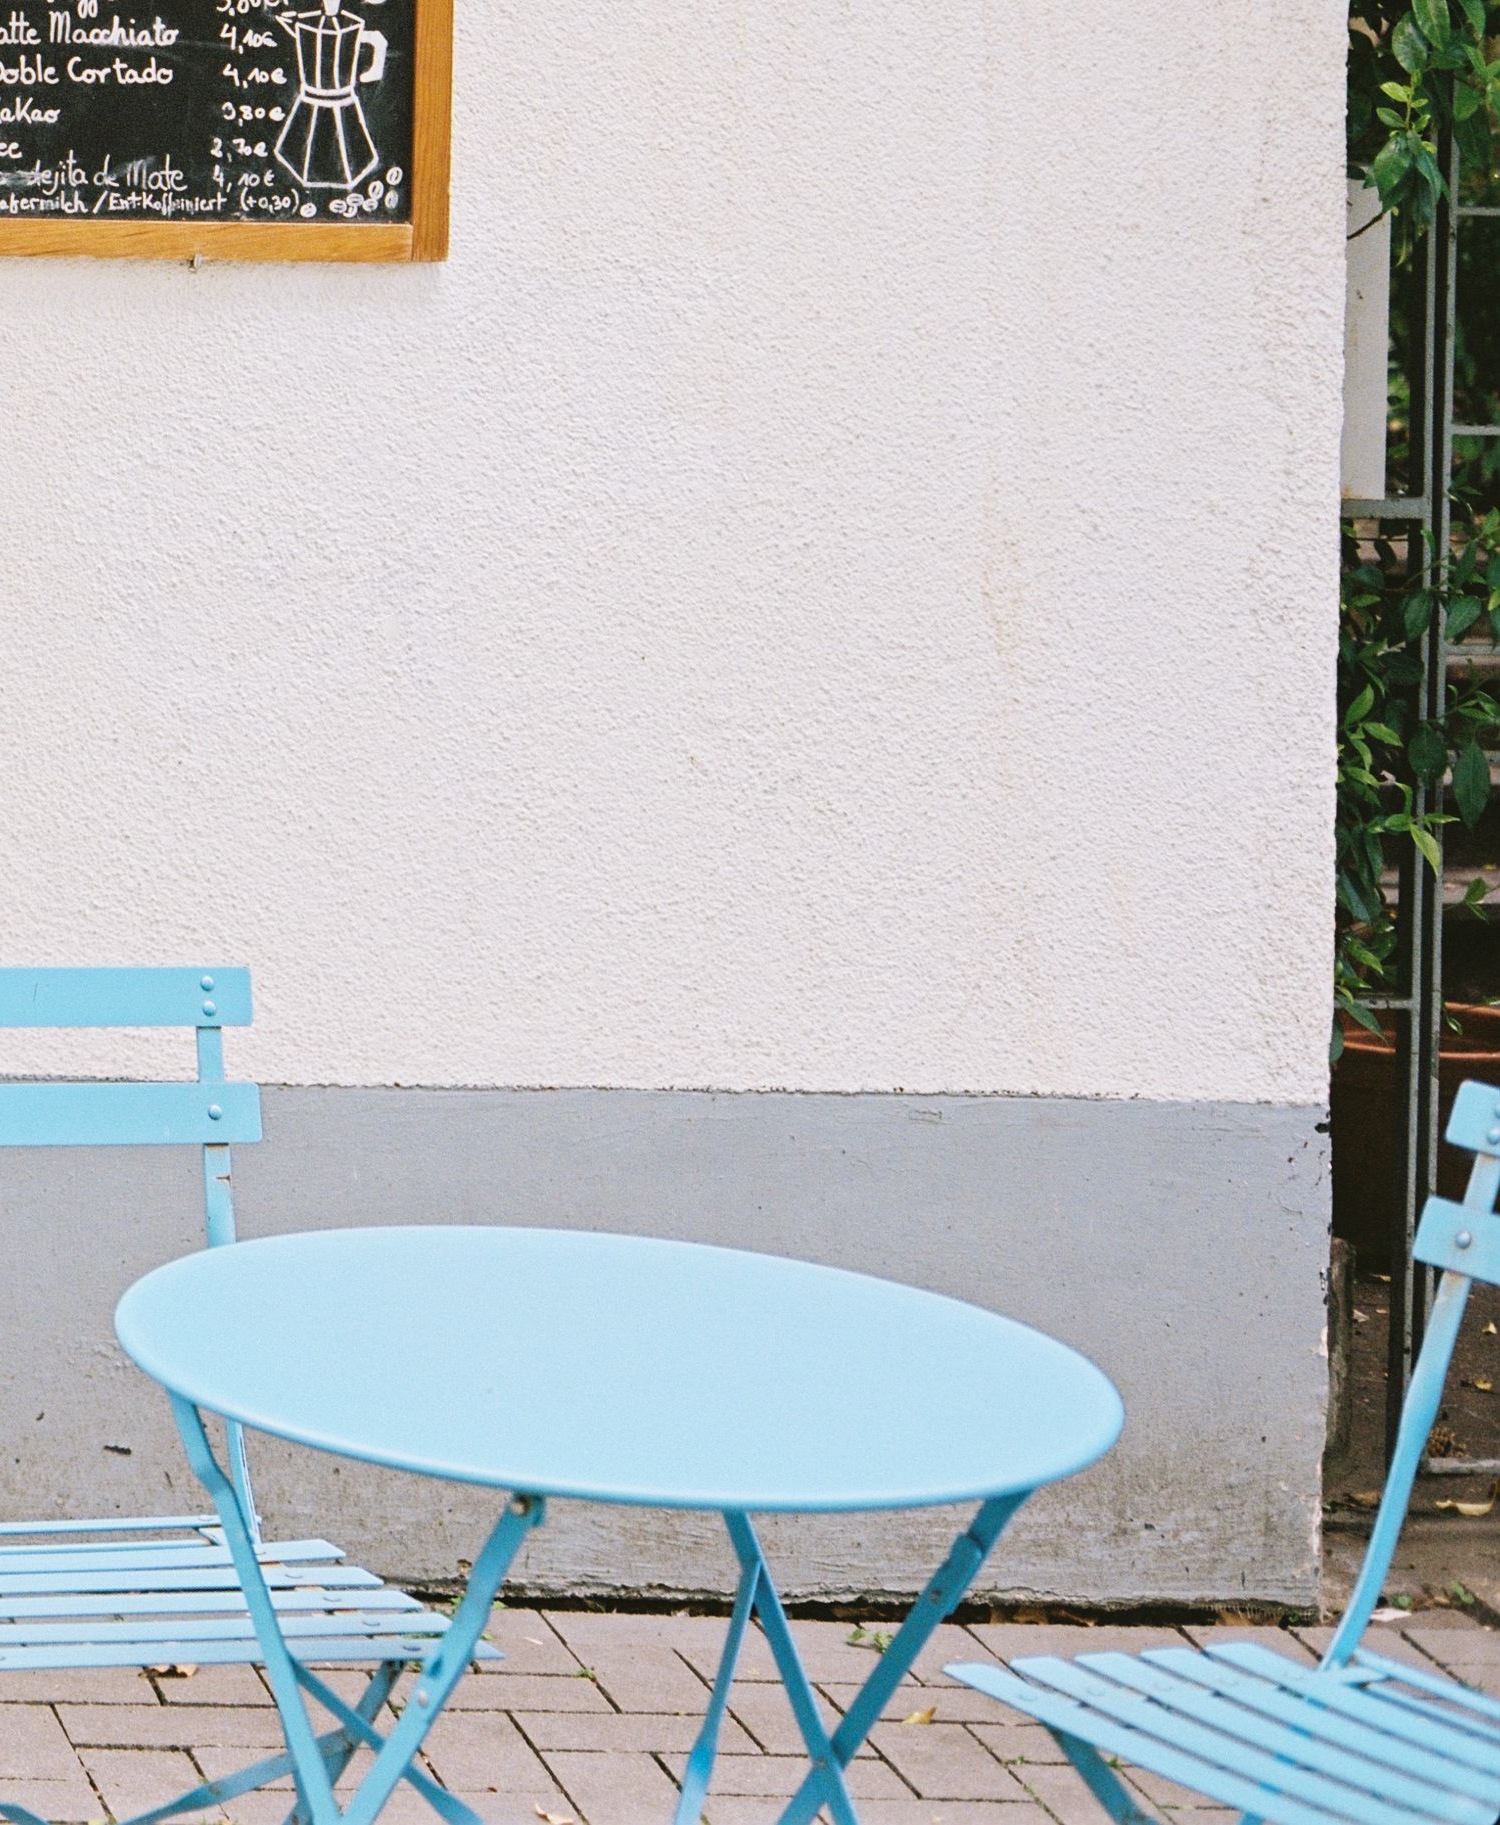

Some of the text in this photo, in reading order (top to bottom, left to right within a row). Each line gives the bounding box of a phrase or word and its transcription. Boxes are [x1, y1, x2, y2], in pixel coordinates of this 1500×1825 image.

[48, 10, 180, 47] Macchiato
[67, 56, 174, 85] Cortado
[93, 152, 120, 188] de
[126, 153, 189, 192] Mate
